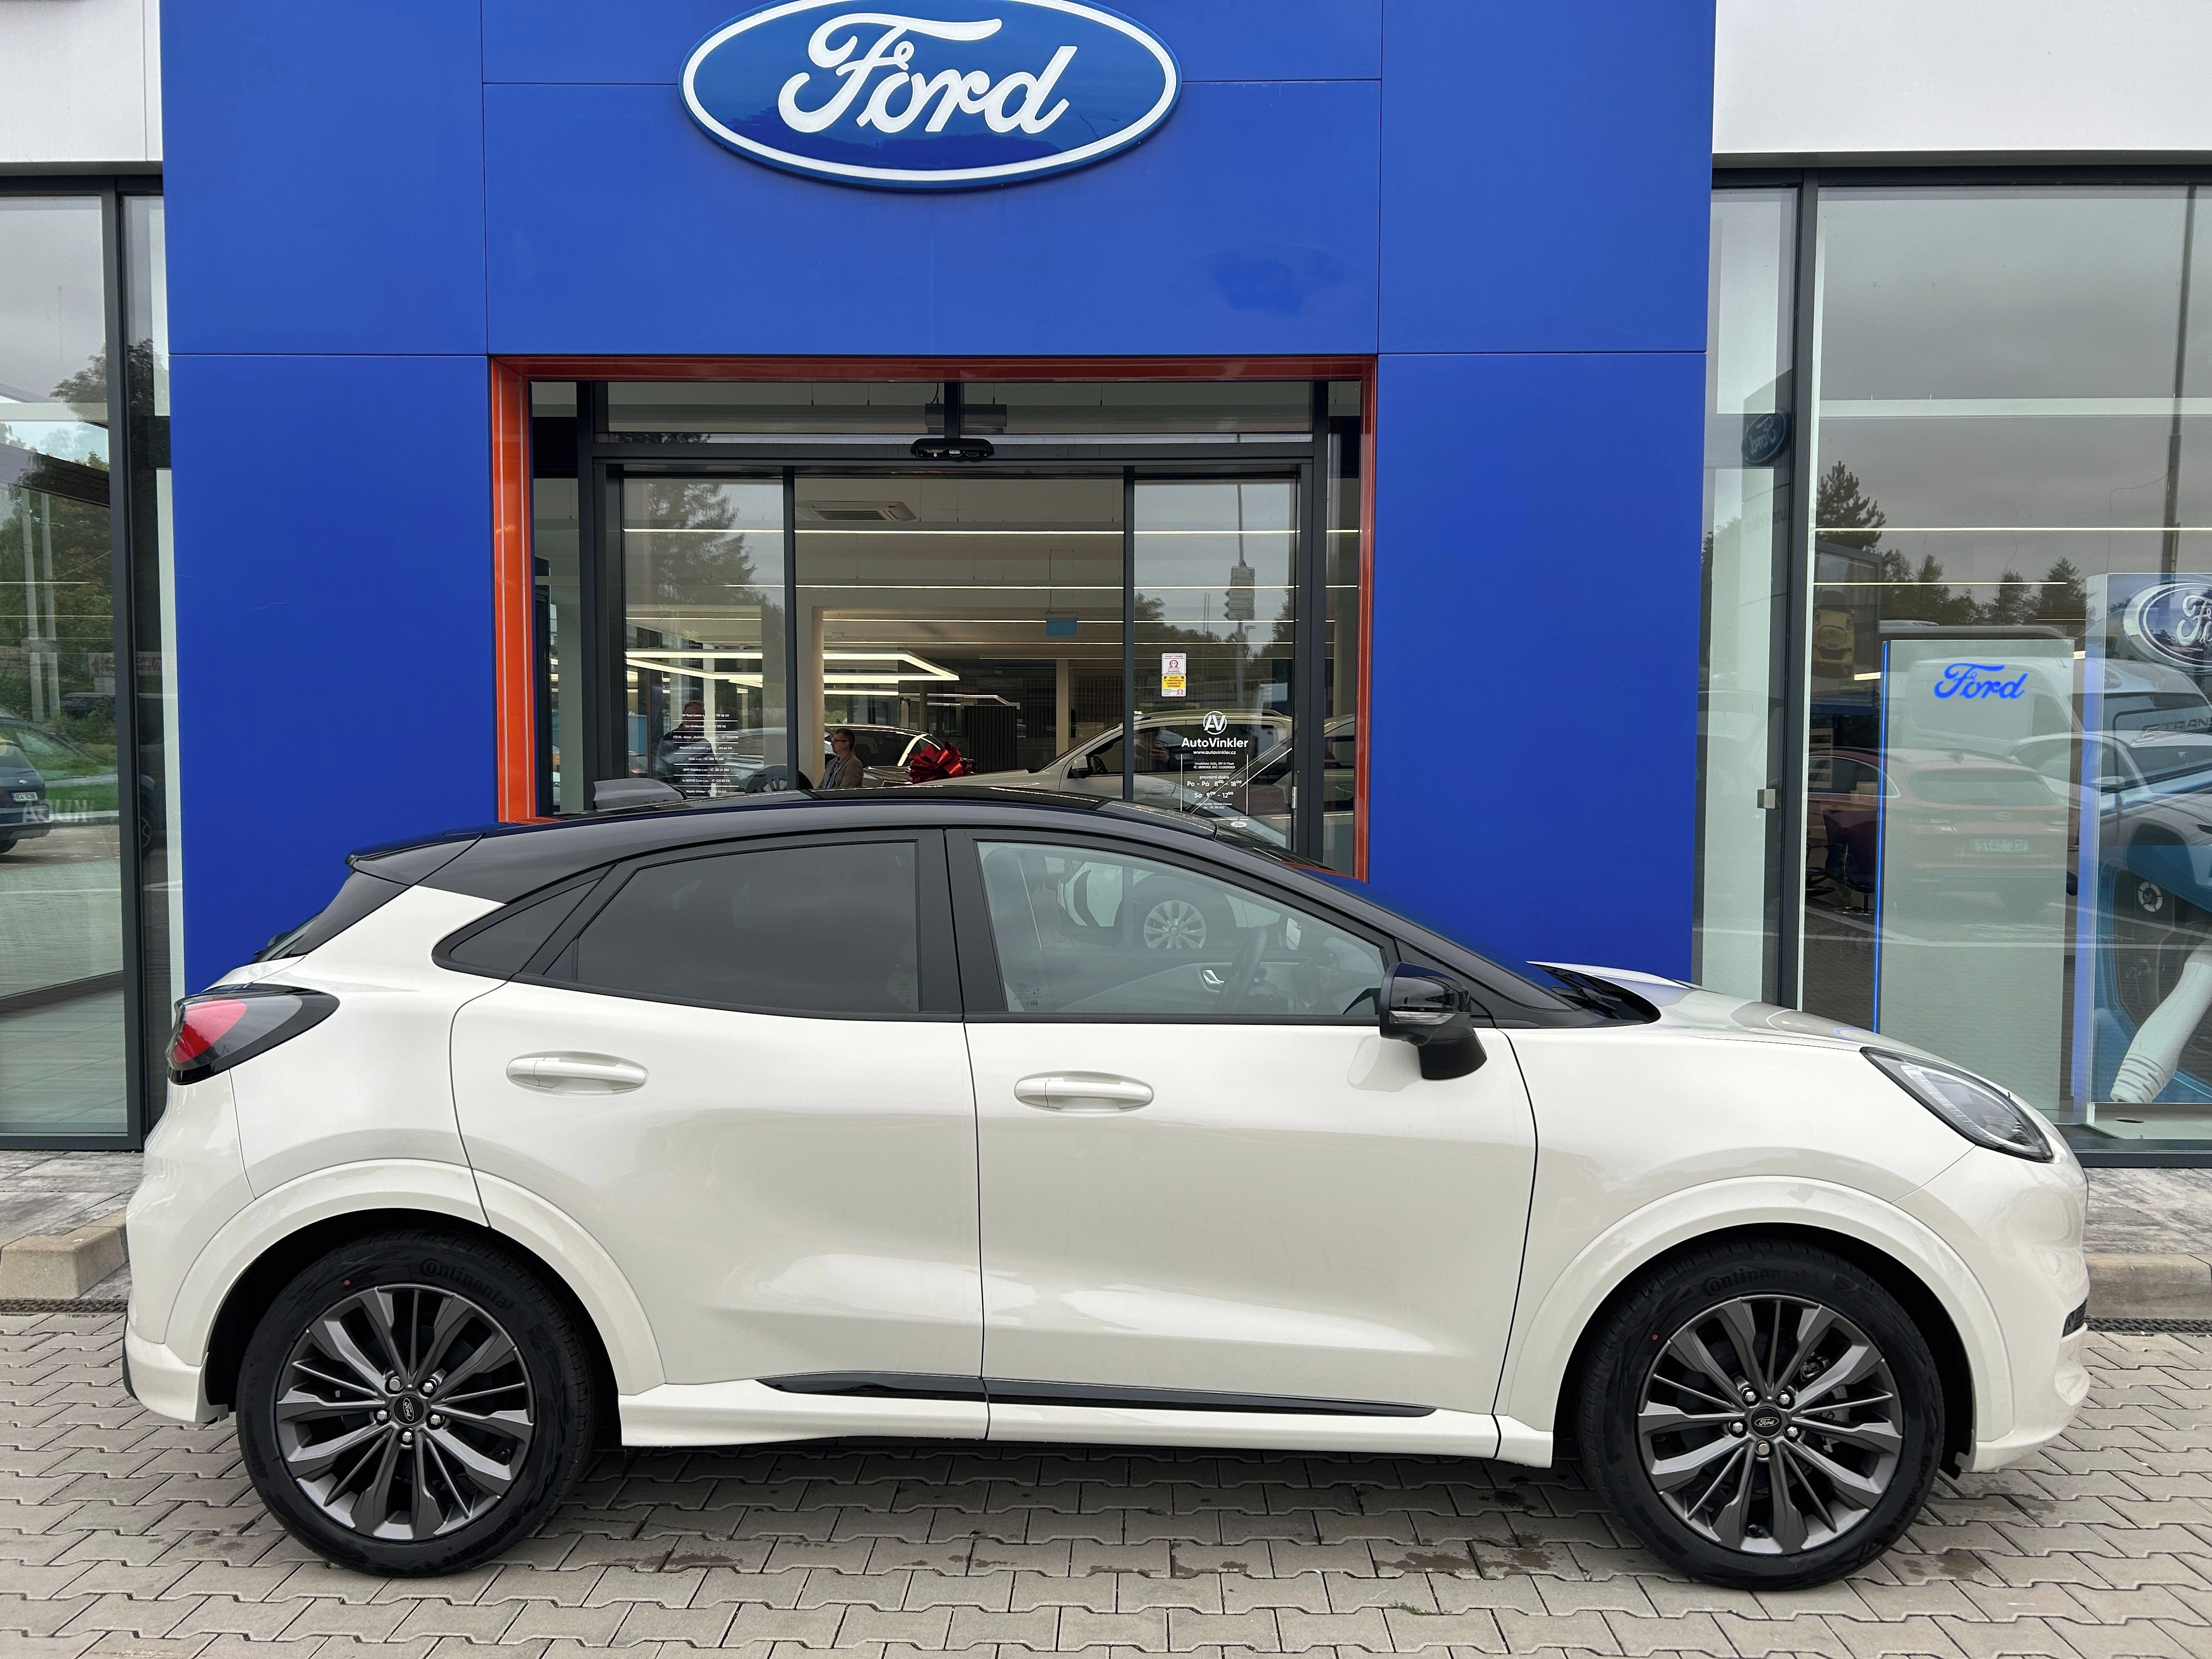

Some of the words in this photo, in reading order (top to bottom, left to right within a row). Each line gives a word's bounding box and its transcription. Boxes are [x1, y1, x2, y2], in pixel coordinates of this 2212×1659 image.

[778, 12, 1077, 134] Ford
[2176, 595, 2212, 646] Fo
[1933, 662, 2028, 699] Ford
[1181, 737, 1249, 748] AutoVinkler
[419, 1257, 516, 1311] Continental
[1702, 1267, 1808, 1296] Continental
